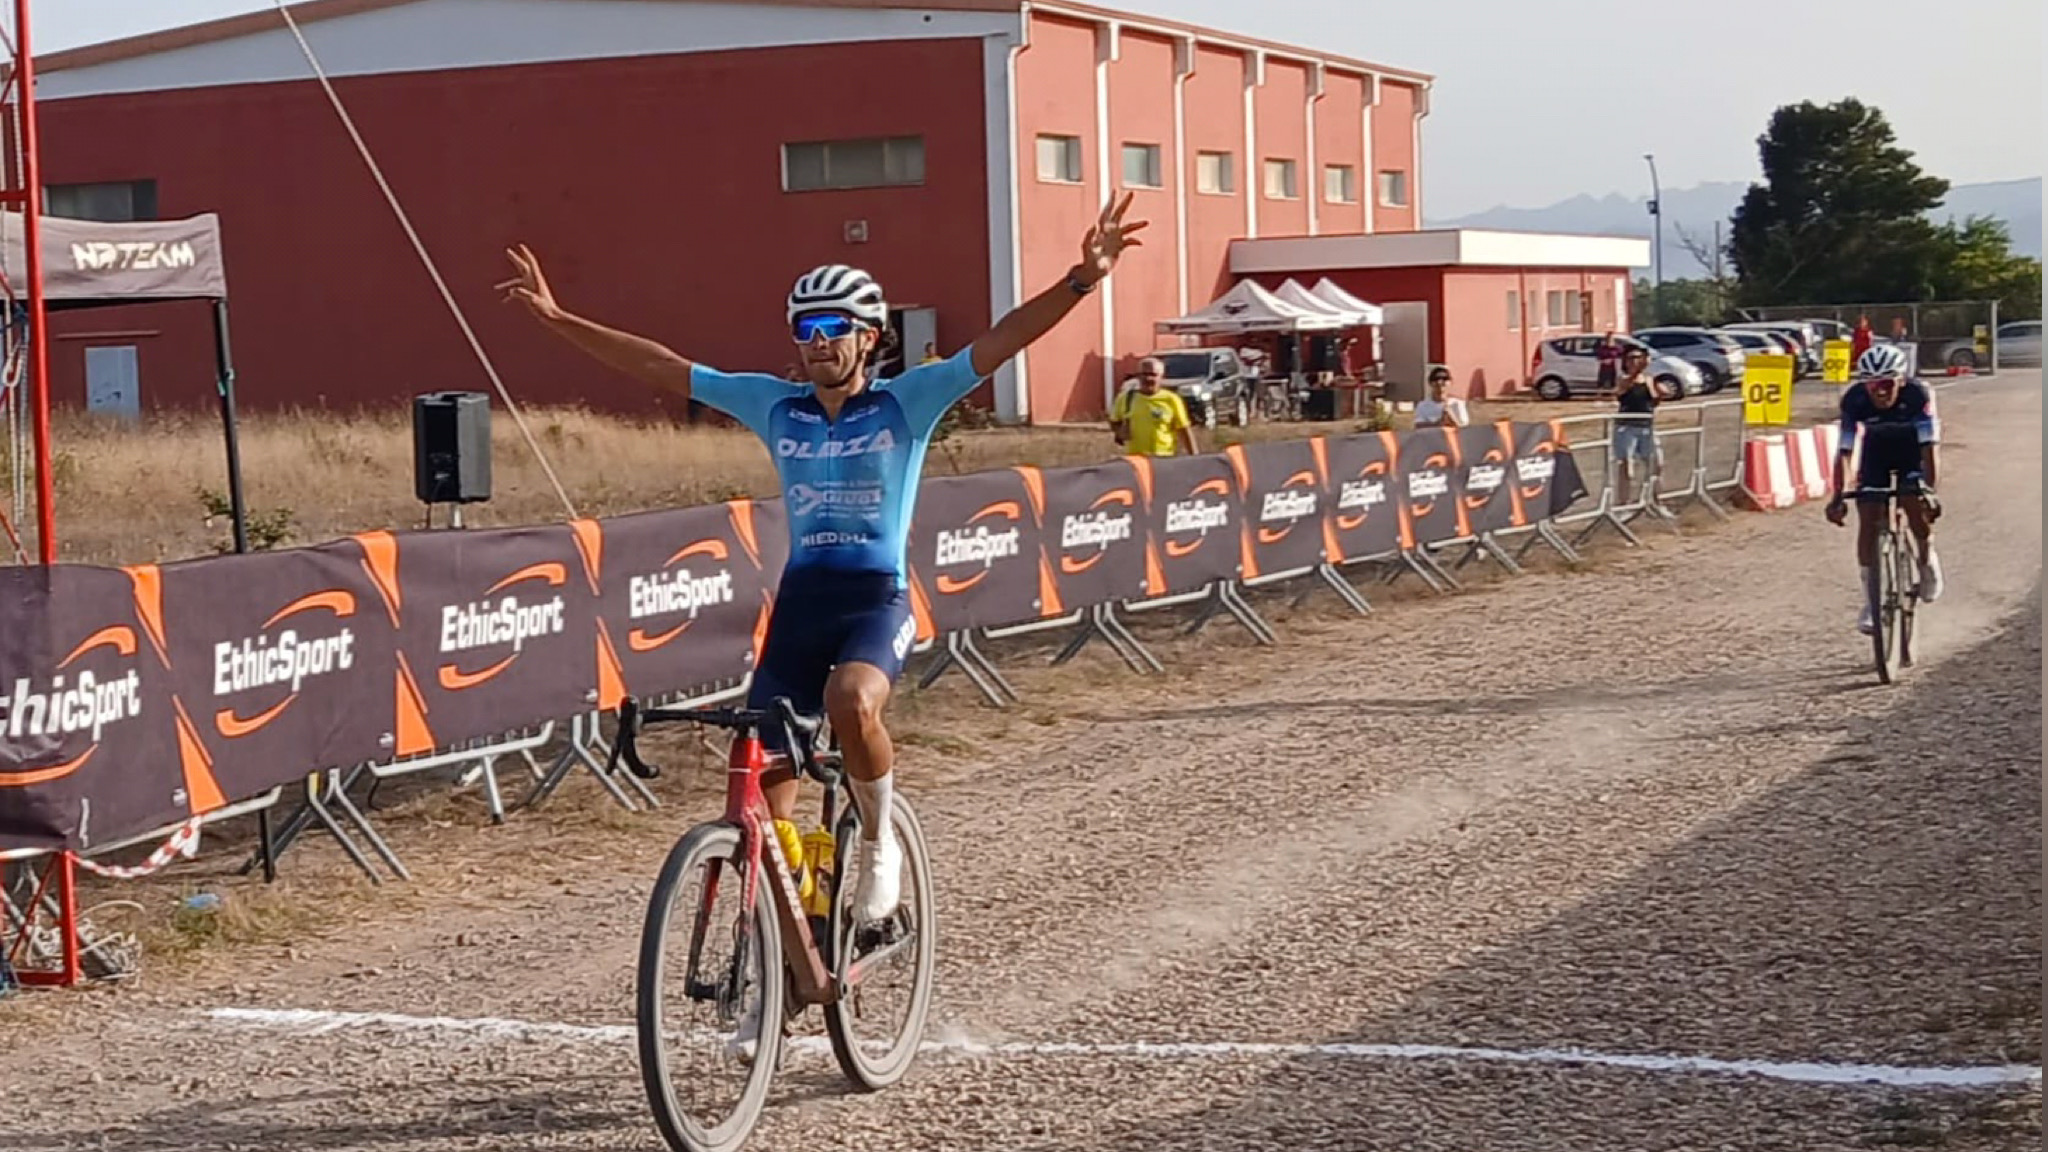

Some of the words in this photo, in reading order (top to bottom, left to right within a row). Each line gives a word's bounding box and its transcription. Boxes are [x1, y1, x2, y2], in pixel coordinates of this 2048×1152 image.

[935, 525, 1019, 568] EthicSport
[1061, 511, 1132, 551] EthicSport
[629, 569, 734, 619] EthicSport
[440, 595, 564, 652] EthicSport
[213, 627, 354, 696] EthicSport
